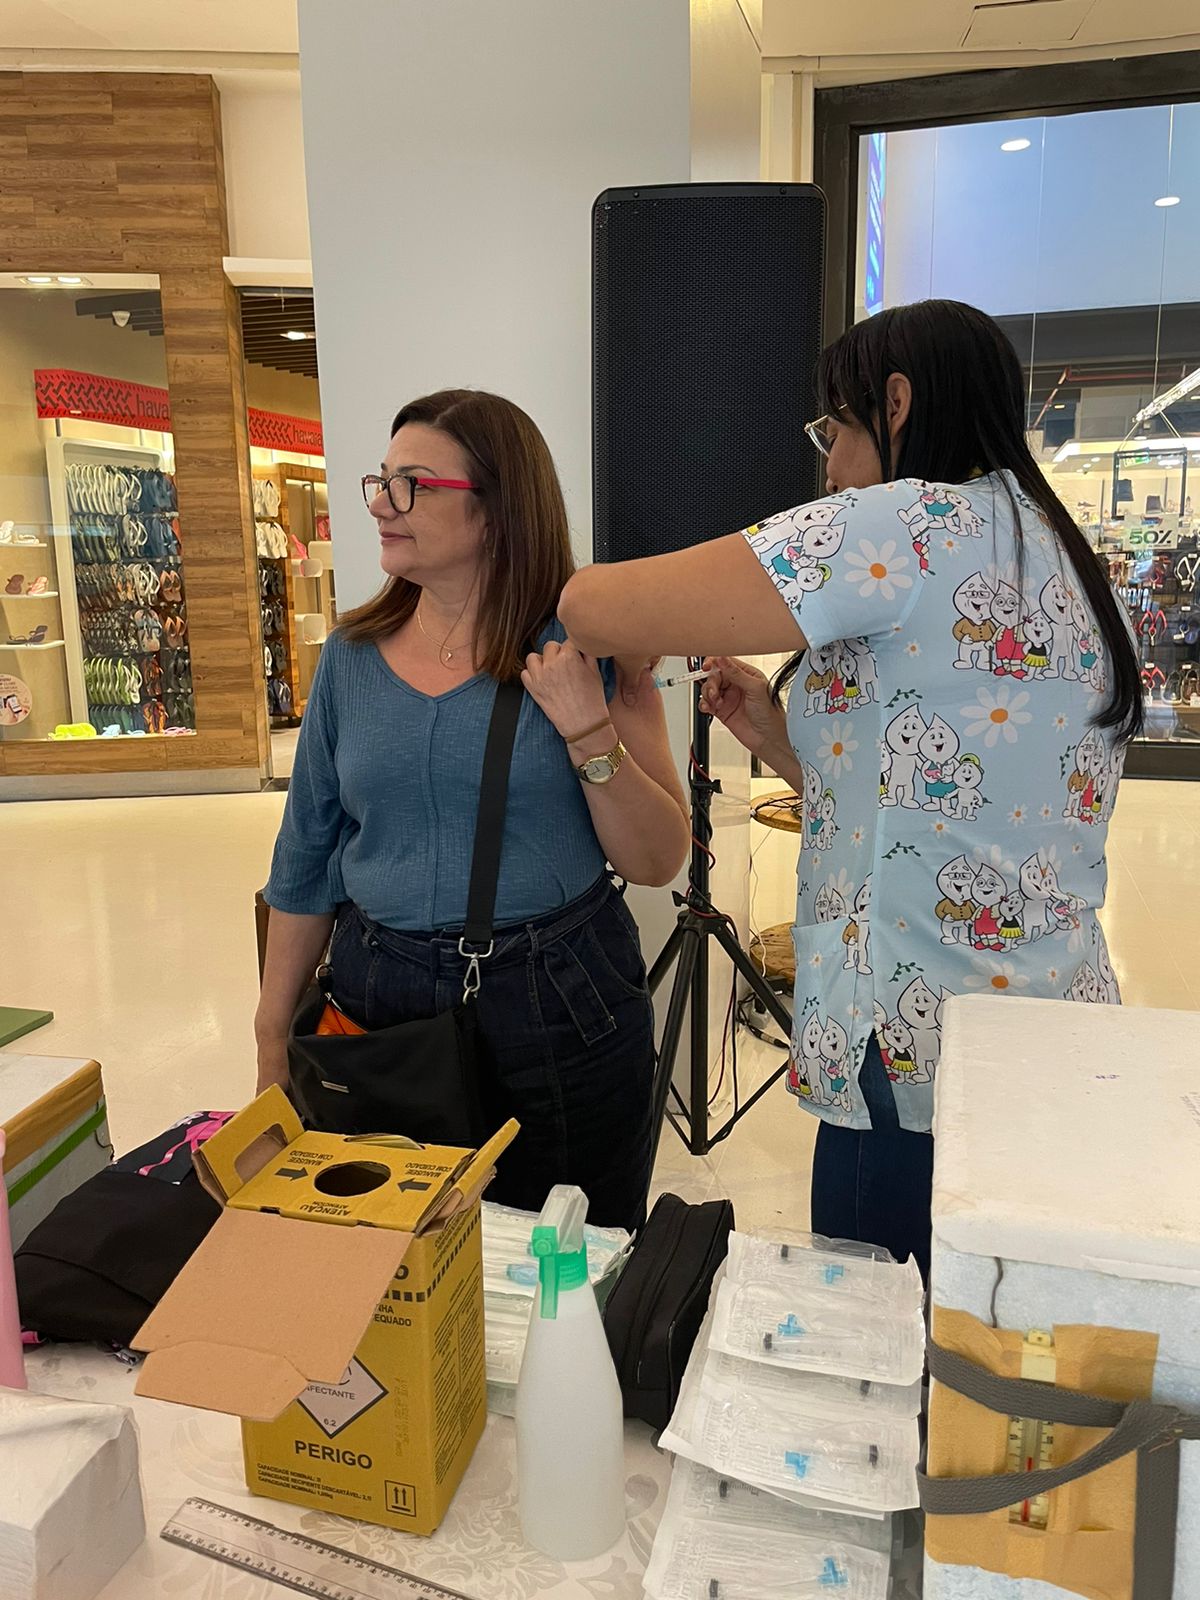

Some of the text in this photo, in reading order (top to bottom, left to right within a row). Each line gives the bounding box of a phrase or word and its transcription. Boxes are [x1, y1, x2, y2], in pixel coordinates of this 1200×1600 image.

[136, 393, 170, 421] hava
[293, 424, 322, 447] havaia
[1129, 529, 1173, 545] 50%
[374, 1313, 412, 1327] EQUADO
[323, 1417, 337, 1427] 6.2
[294, 1439, 373, 1470] PERIGO
